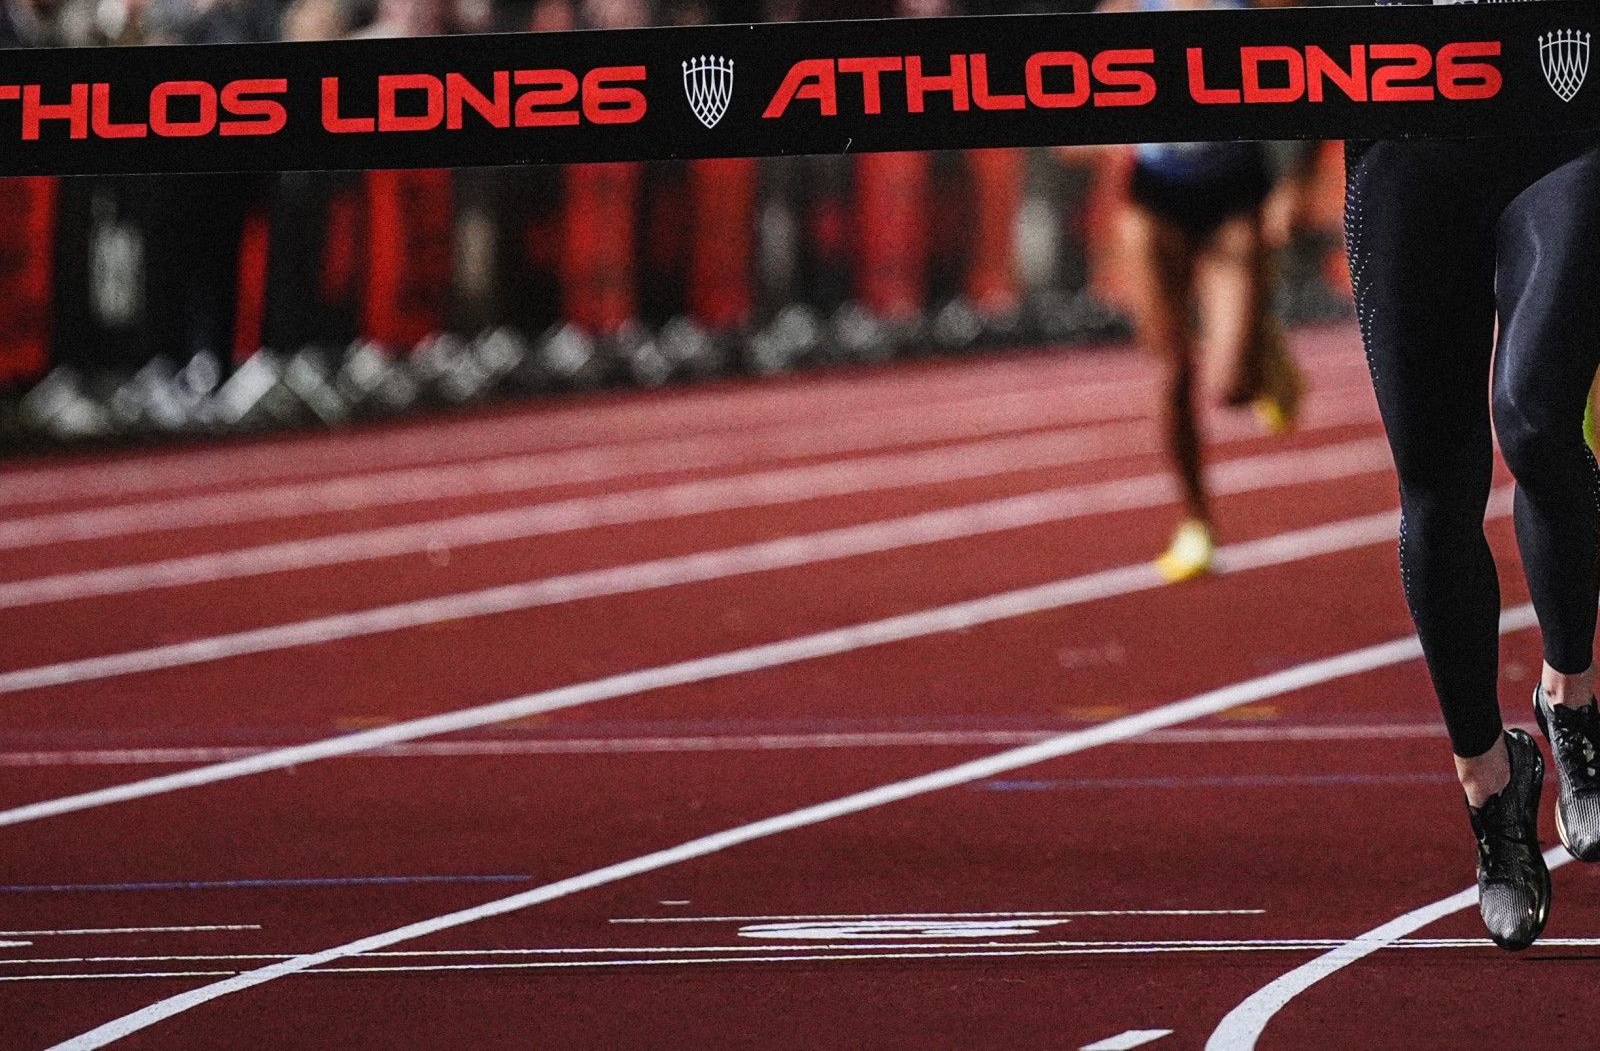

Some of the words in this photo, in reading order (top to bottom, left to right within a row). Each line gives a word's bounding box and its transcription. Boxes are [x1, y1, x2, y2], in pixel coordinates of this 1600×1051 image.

[0, 78, 288, 141] HLOS
[321, 65, 648, 134] LDN26
[762, 48, 1157, 118] ATHLOS
[1186, 41, 1503, 105] LDN26
